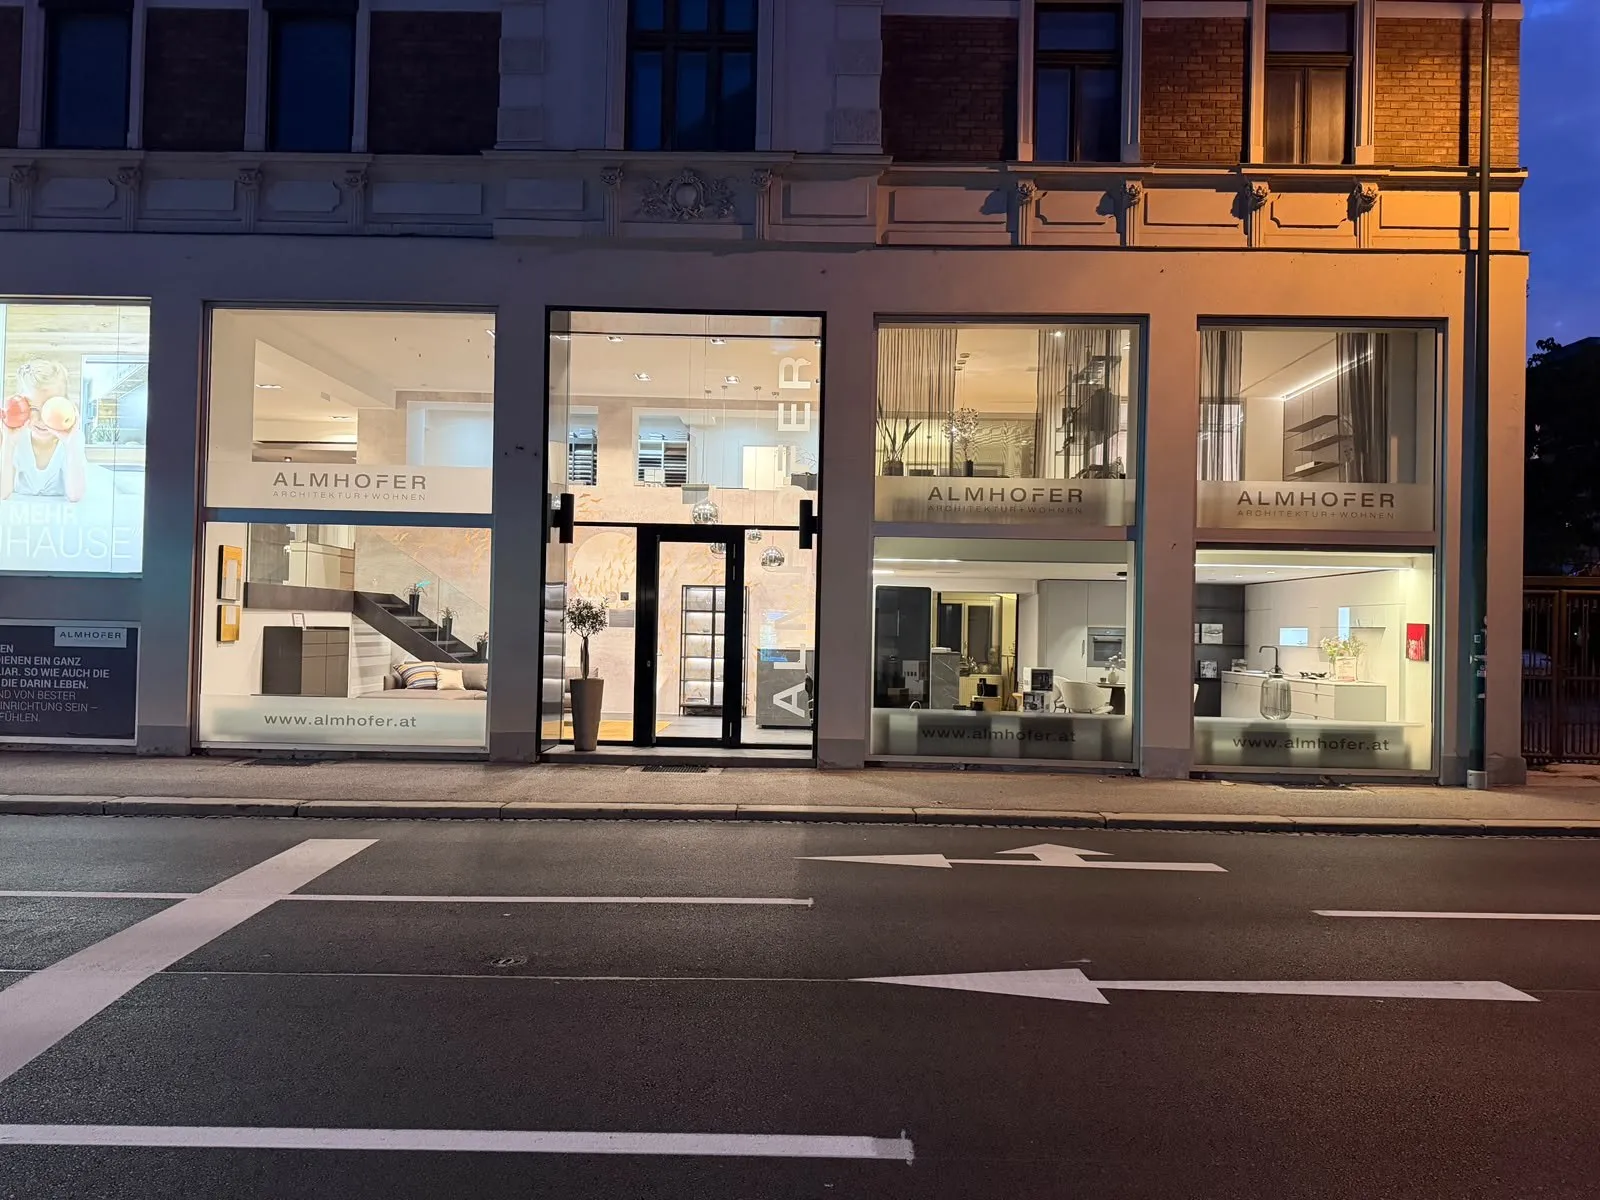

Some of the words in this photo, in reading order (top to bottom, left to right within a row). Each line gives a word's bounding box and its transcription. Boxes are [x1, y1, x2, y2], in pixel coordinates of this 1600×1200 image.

[273, 472, 426, 490] ALMHOFER
[272, 490, 426, 501] ARCHITEKTUR+WOHNEN
[928, 486, 1083, 503] ALMHOFER
[1237, 490, 1395, 508] ALMHOFER
[9, 503, 78, 525] MEHR
[1237, 509, 1395, 520] ARCHITEKTUR+WOHNEN
[59, 631, 122, 639] ALMHOFER
[0, 655, 32, 665] IENEN
[34, 656, 51, 666] EIN
[53, 656, 82, 666] GANZ
[24, 667, 38, 677] SO
[40, 668, 60, 678] WIE
[61, 668, 91, 678] AUCH
[93, 669, 110, 679] DIE
[1, 678, 18, 688] DIE
[20, 678, 51, 689] DARIN
[54, 679, 89, 690] LEBEN.
[13, 690, 35, 700] VON
[37, 690, 76, 701] BESTER
[65, 702, 88, 713] SEIN
[264, 714, 417, 728] www.almhofer.at
[922, 728, 1076, 743] www.almhofer.at
[1232, 737, 1390, 751] www.almhofer.at
